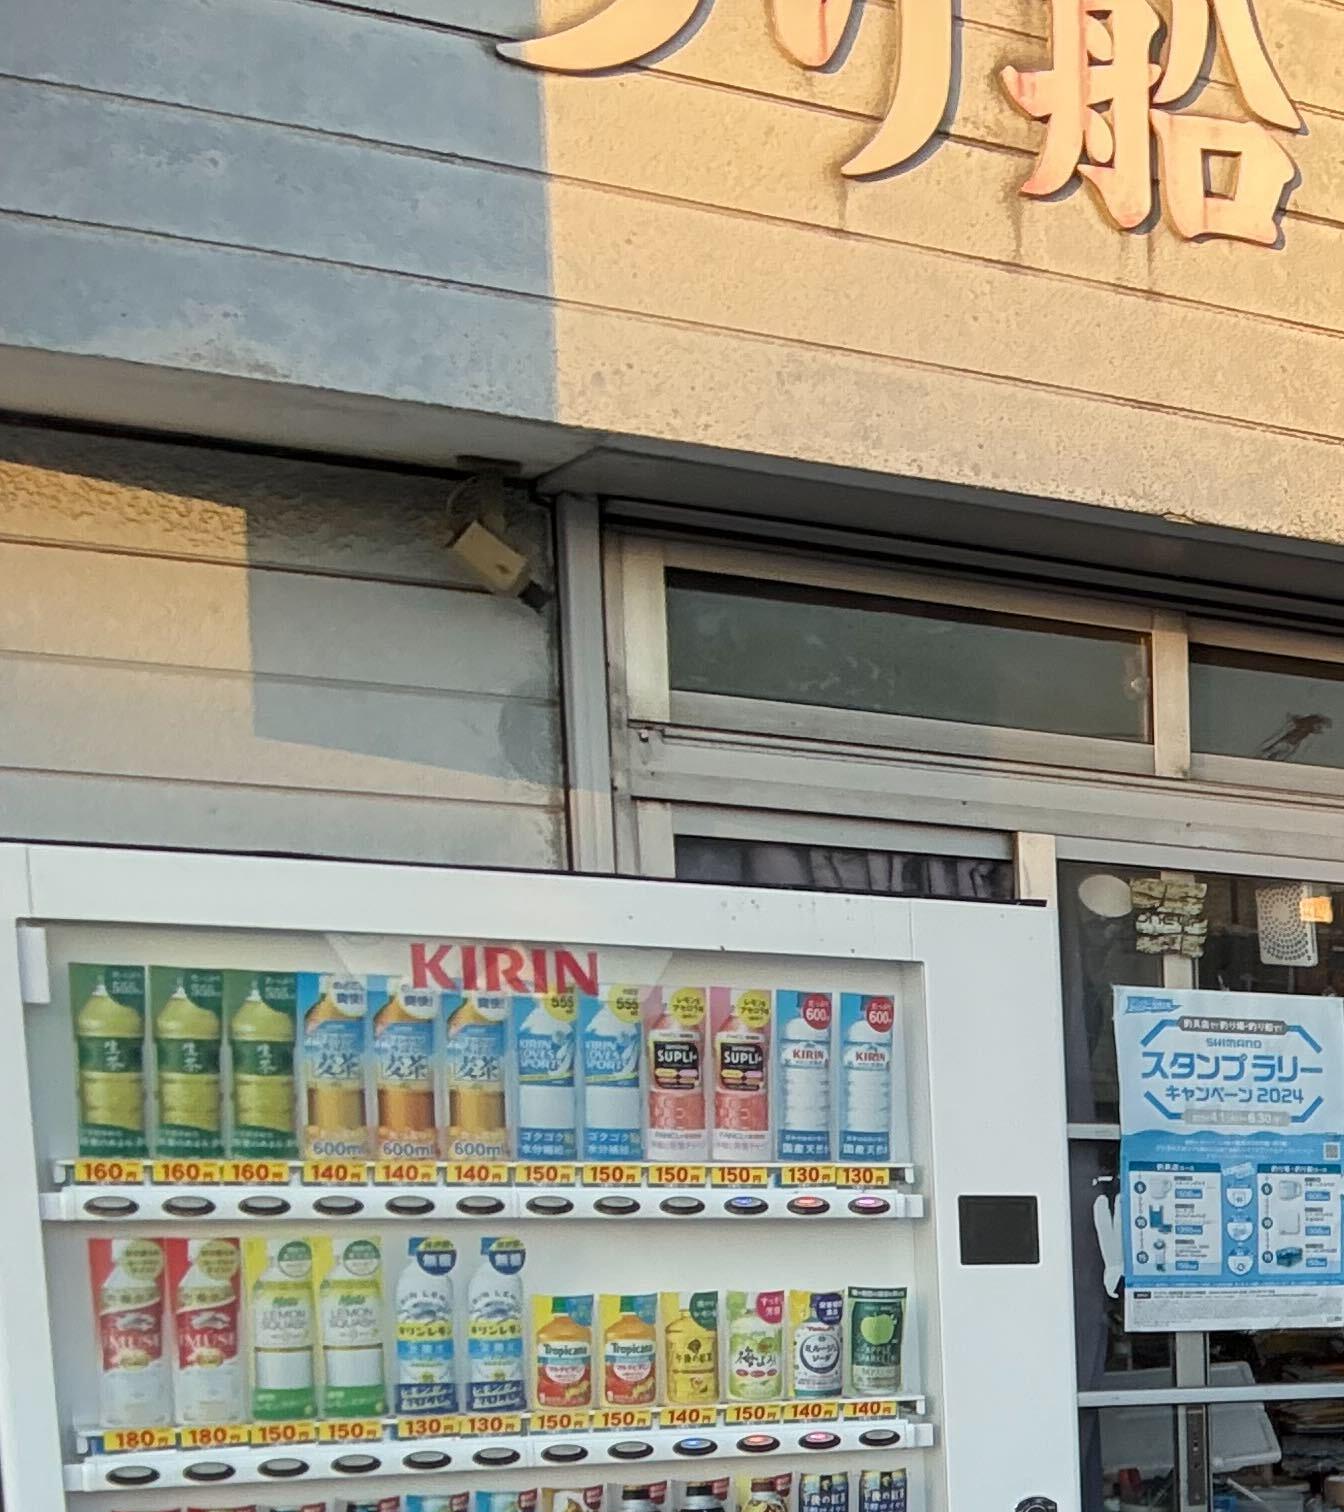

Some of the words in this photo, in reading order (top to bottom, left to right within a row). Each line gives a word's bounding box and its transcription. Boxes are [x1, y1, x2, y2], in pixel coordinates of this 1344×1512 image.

[409, 942, 598, 997] KIRIN
[1206, 1037, 1262, 1049] SHIMANO
[793, 1049, 824, 1060] KIRIN
[1141, 1051, 1323, 1083] スタンプラリー
[1257, 1087, 1304, 1105] 2024
